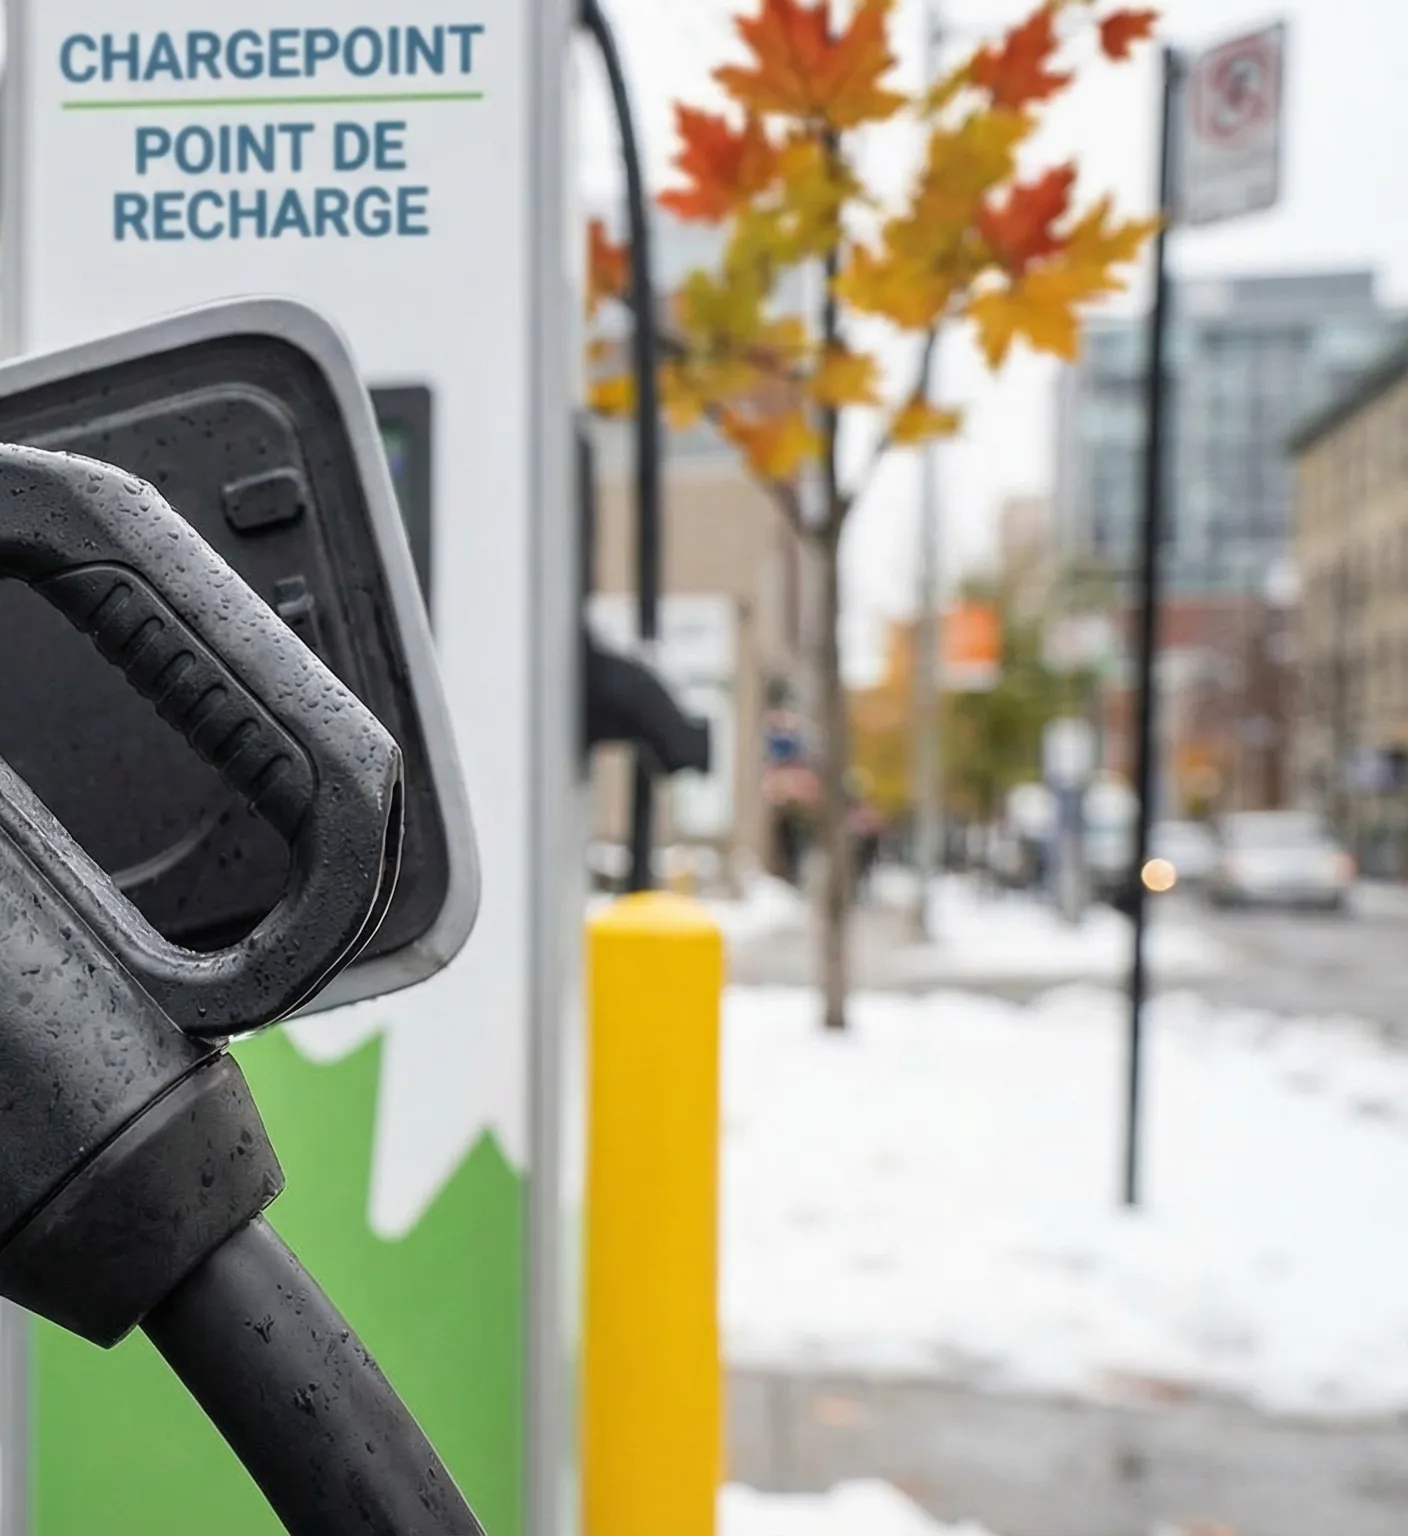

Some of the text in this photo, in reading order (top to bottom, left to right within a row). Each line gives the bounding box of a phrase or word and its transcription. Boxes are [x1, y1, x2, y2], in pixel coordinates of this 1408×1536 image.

[59, 24, 485, 83] CHARGEPOINT
[135, 121, 407, 175] POINT DE
[113, 186, 430, 241] RECHARGE
